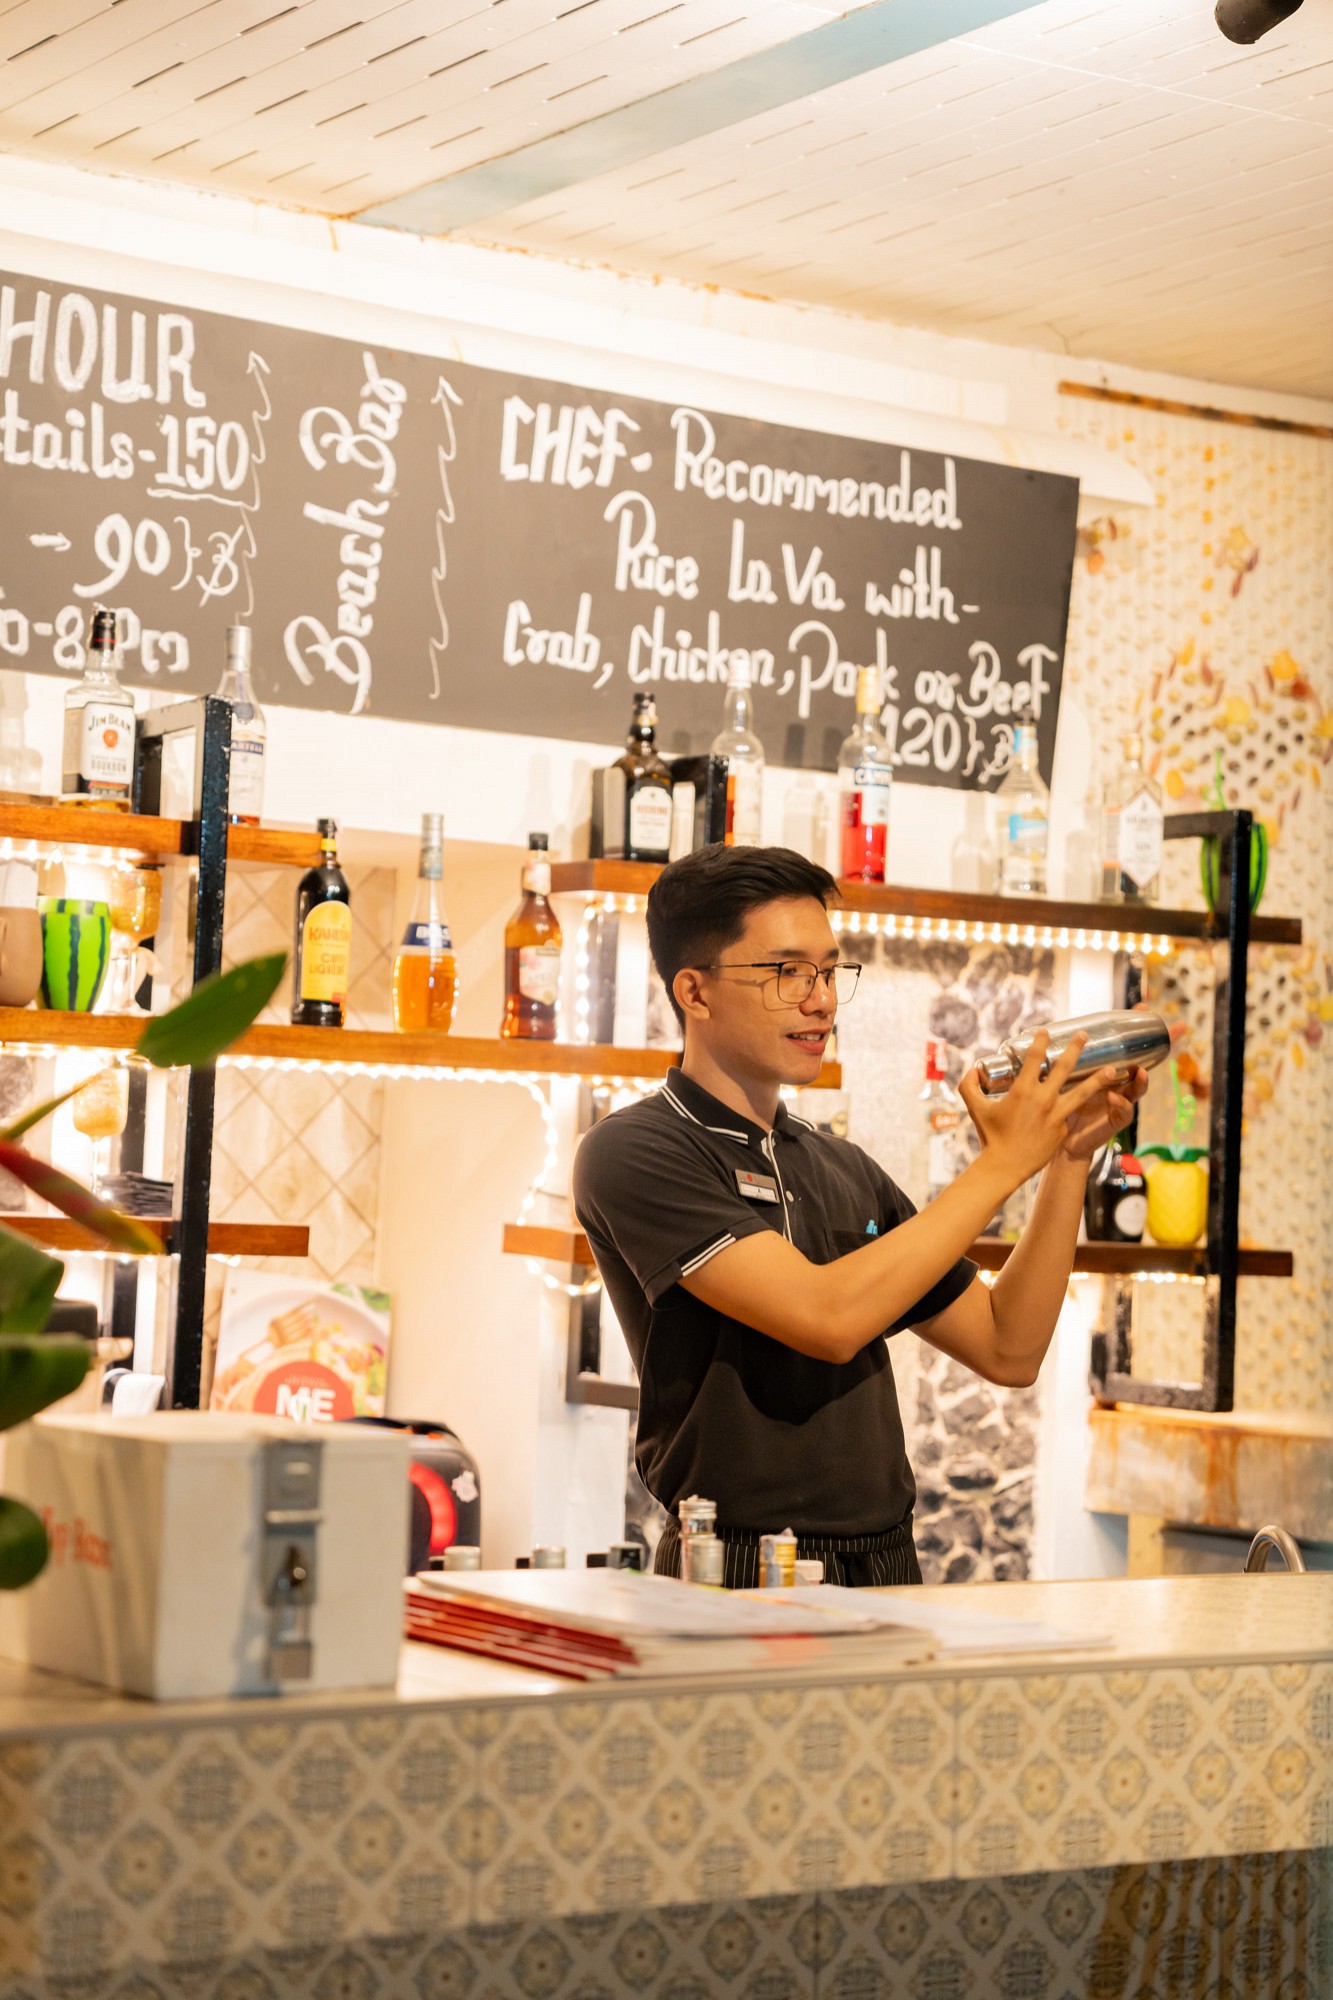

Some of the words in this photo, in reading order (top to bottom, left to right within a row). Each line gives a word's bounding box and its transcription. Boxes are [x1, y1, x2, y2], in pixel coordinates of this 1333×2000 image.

[0, 286, 207, 408] HOUR
[0, 388, 250, 491] tails-150
[299, 351, 407, 494] Bar
[670, 407, 962, 531] Recommended
[604, 490, 699, 600] Rice
[284, 499, 391, 715] Beach
[788, 620, 900, 719] Pok
[915, 670, 961, 711] or
